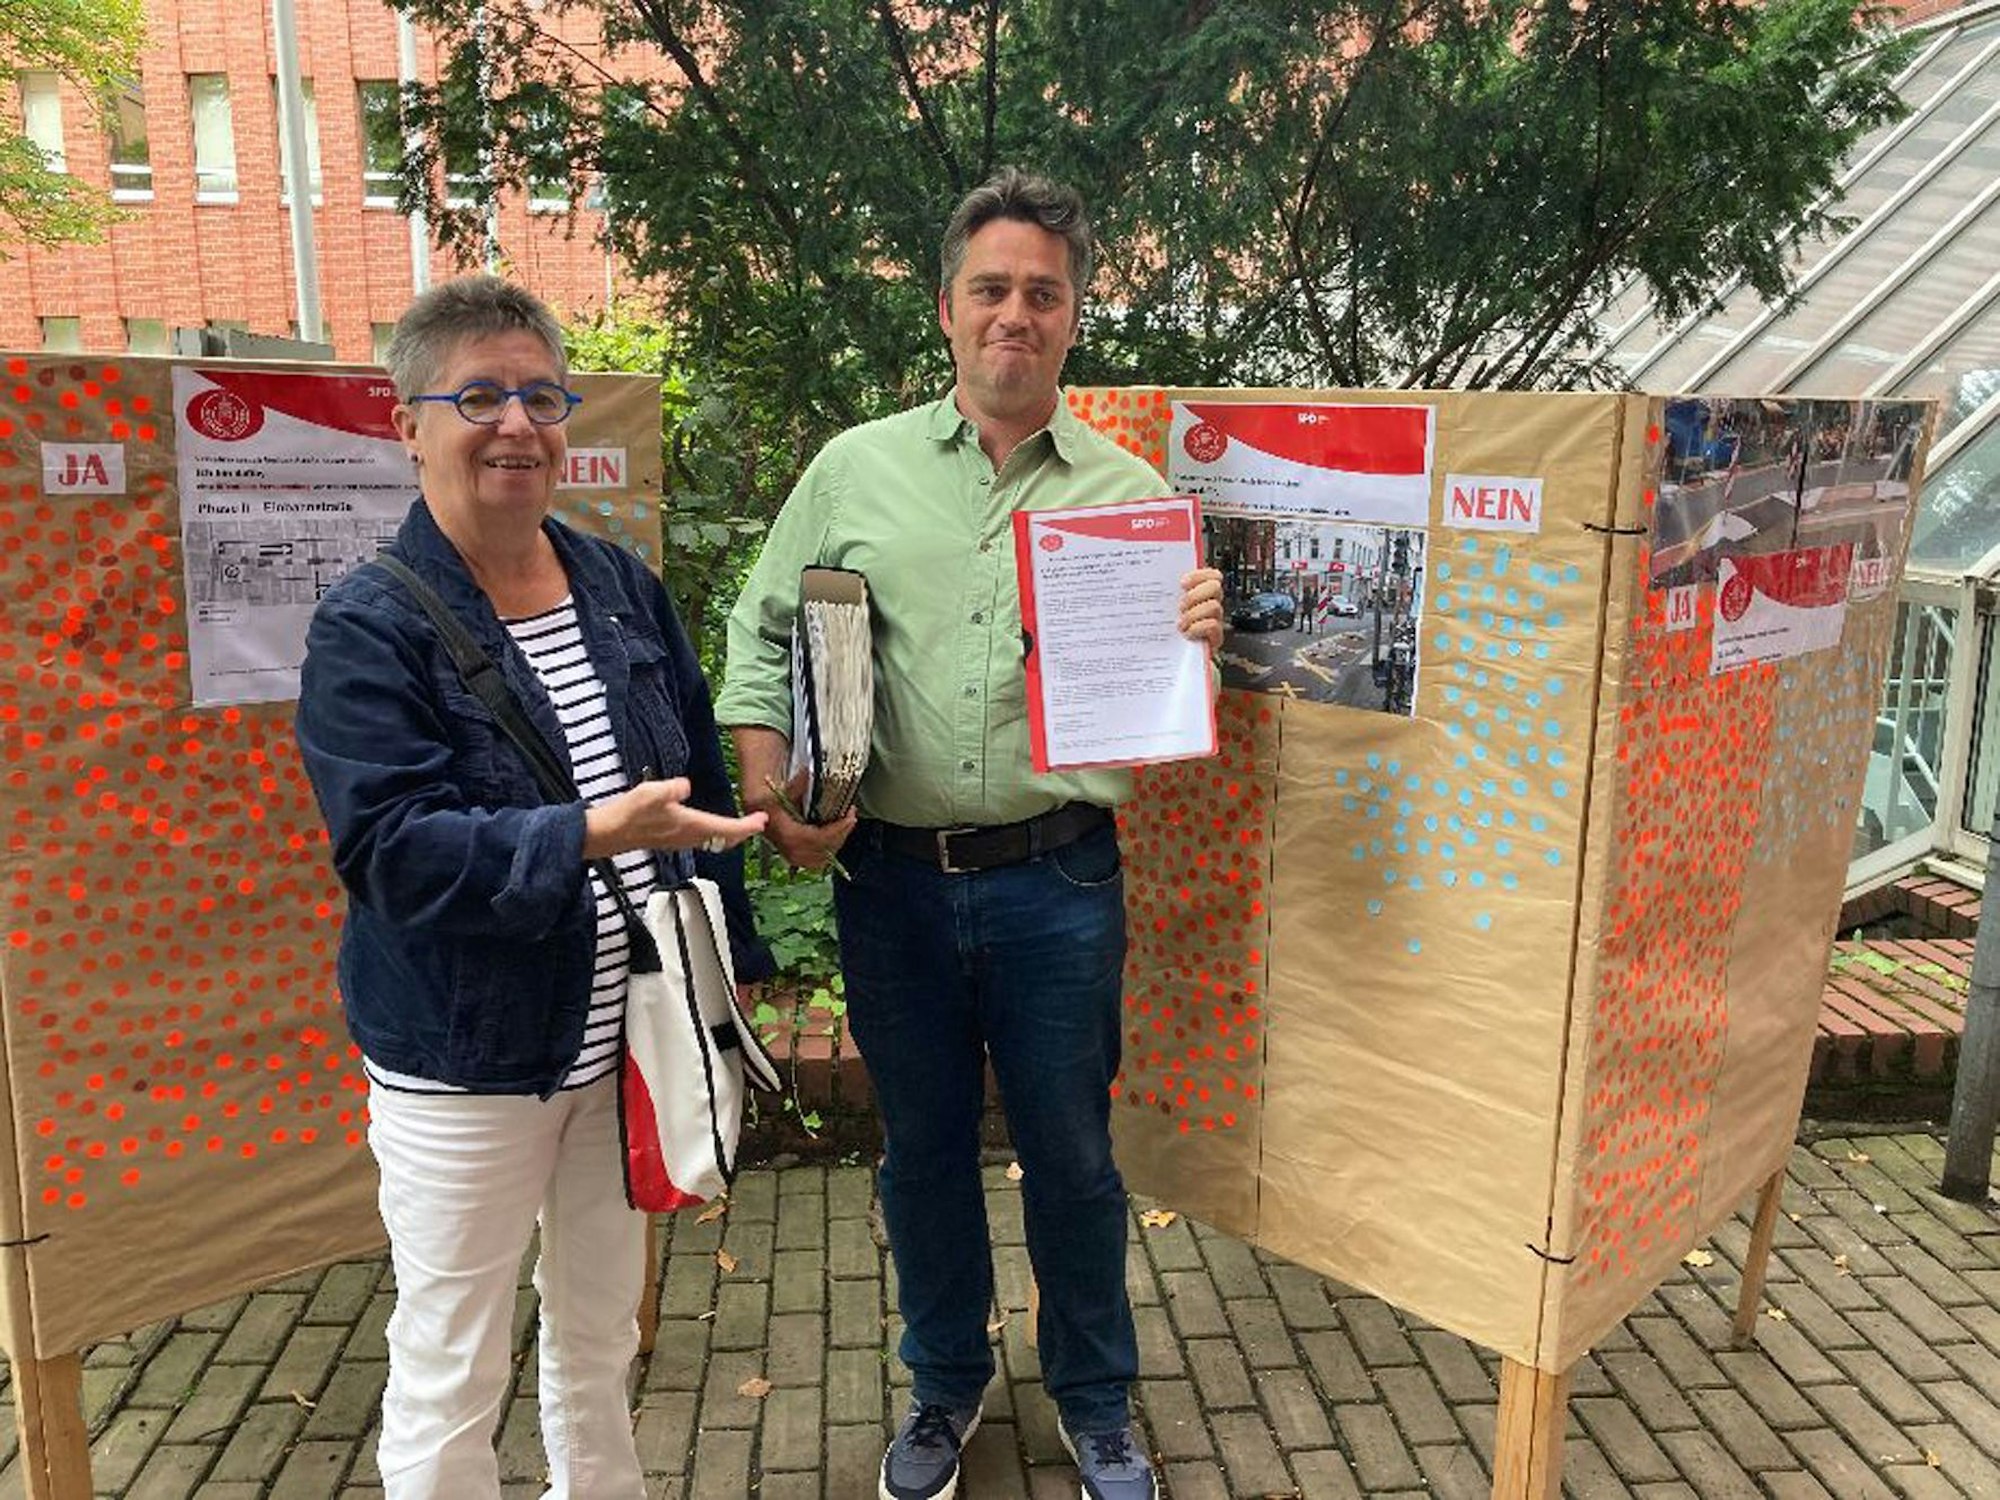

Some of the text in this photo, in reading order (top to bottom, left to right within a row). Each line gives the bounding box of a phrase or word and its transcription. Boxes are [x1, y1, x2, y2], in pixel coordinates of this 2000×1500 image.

[58, 453, 109, 486] JA
[1452, 486, 1533, 522] NEIN
[1670, 590, 1691, 623] JA
